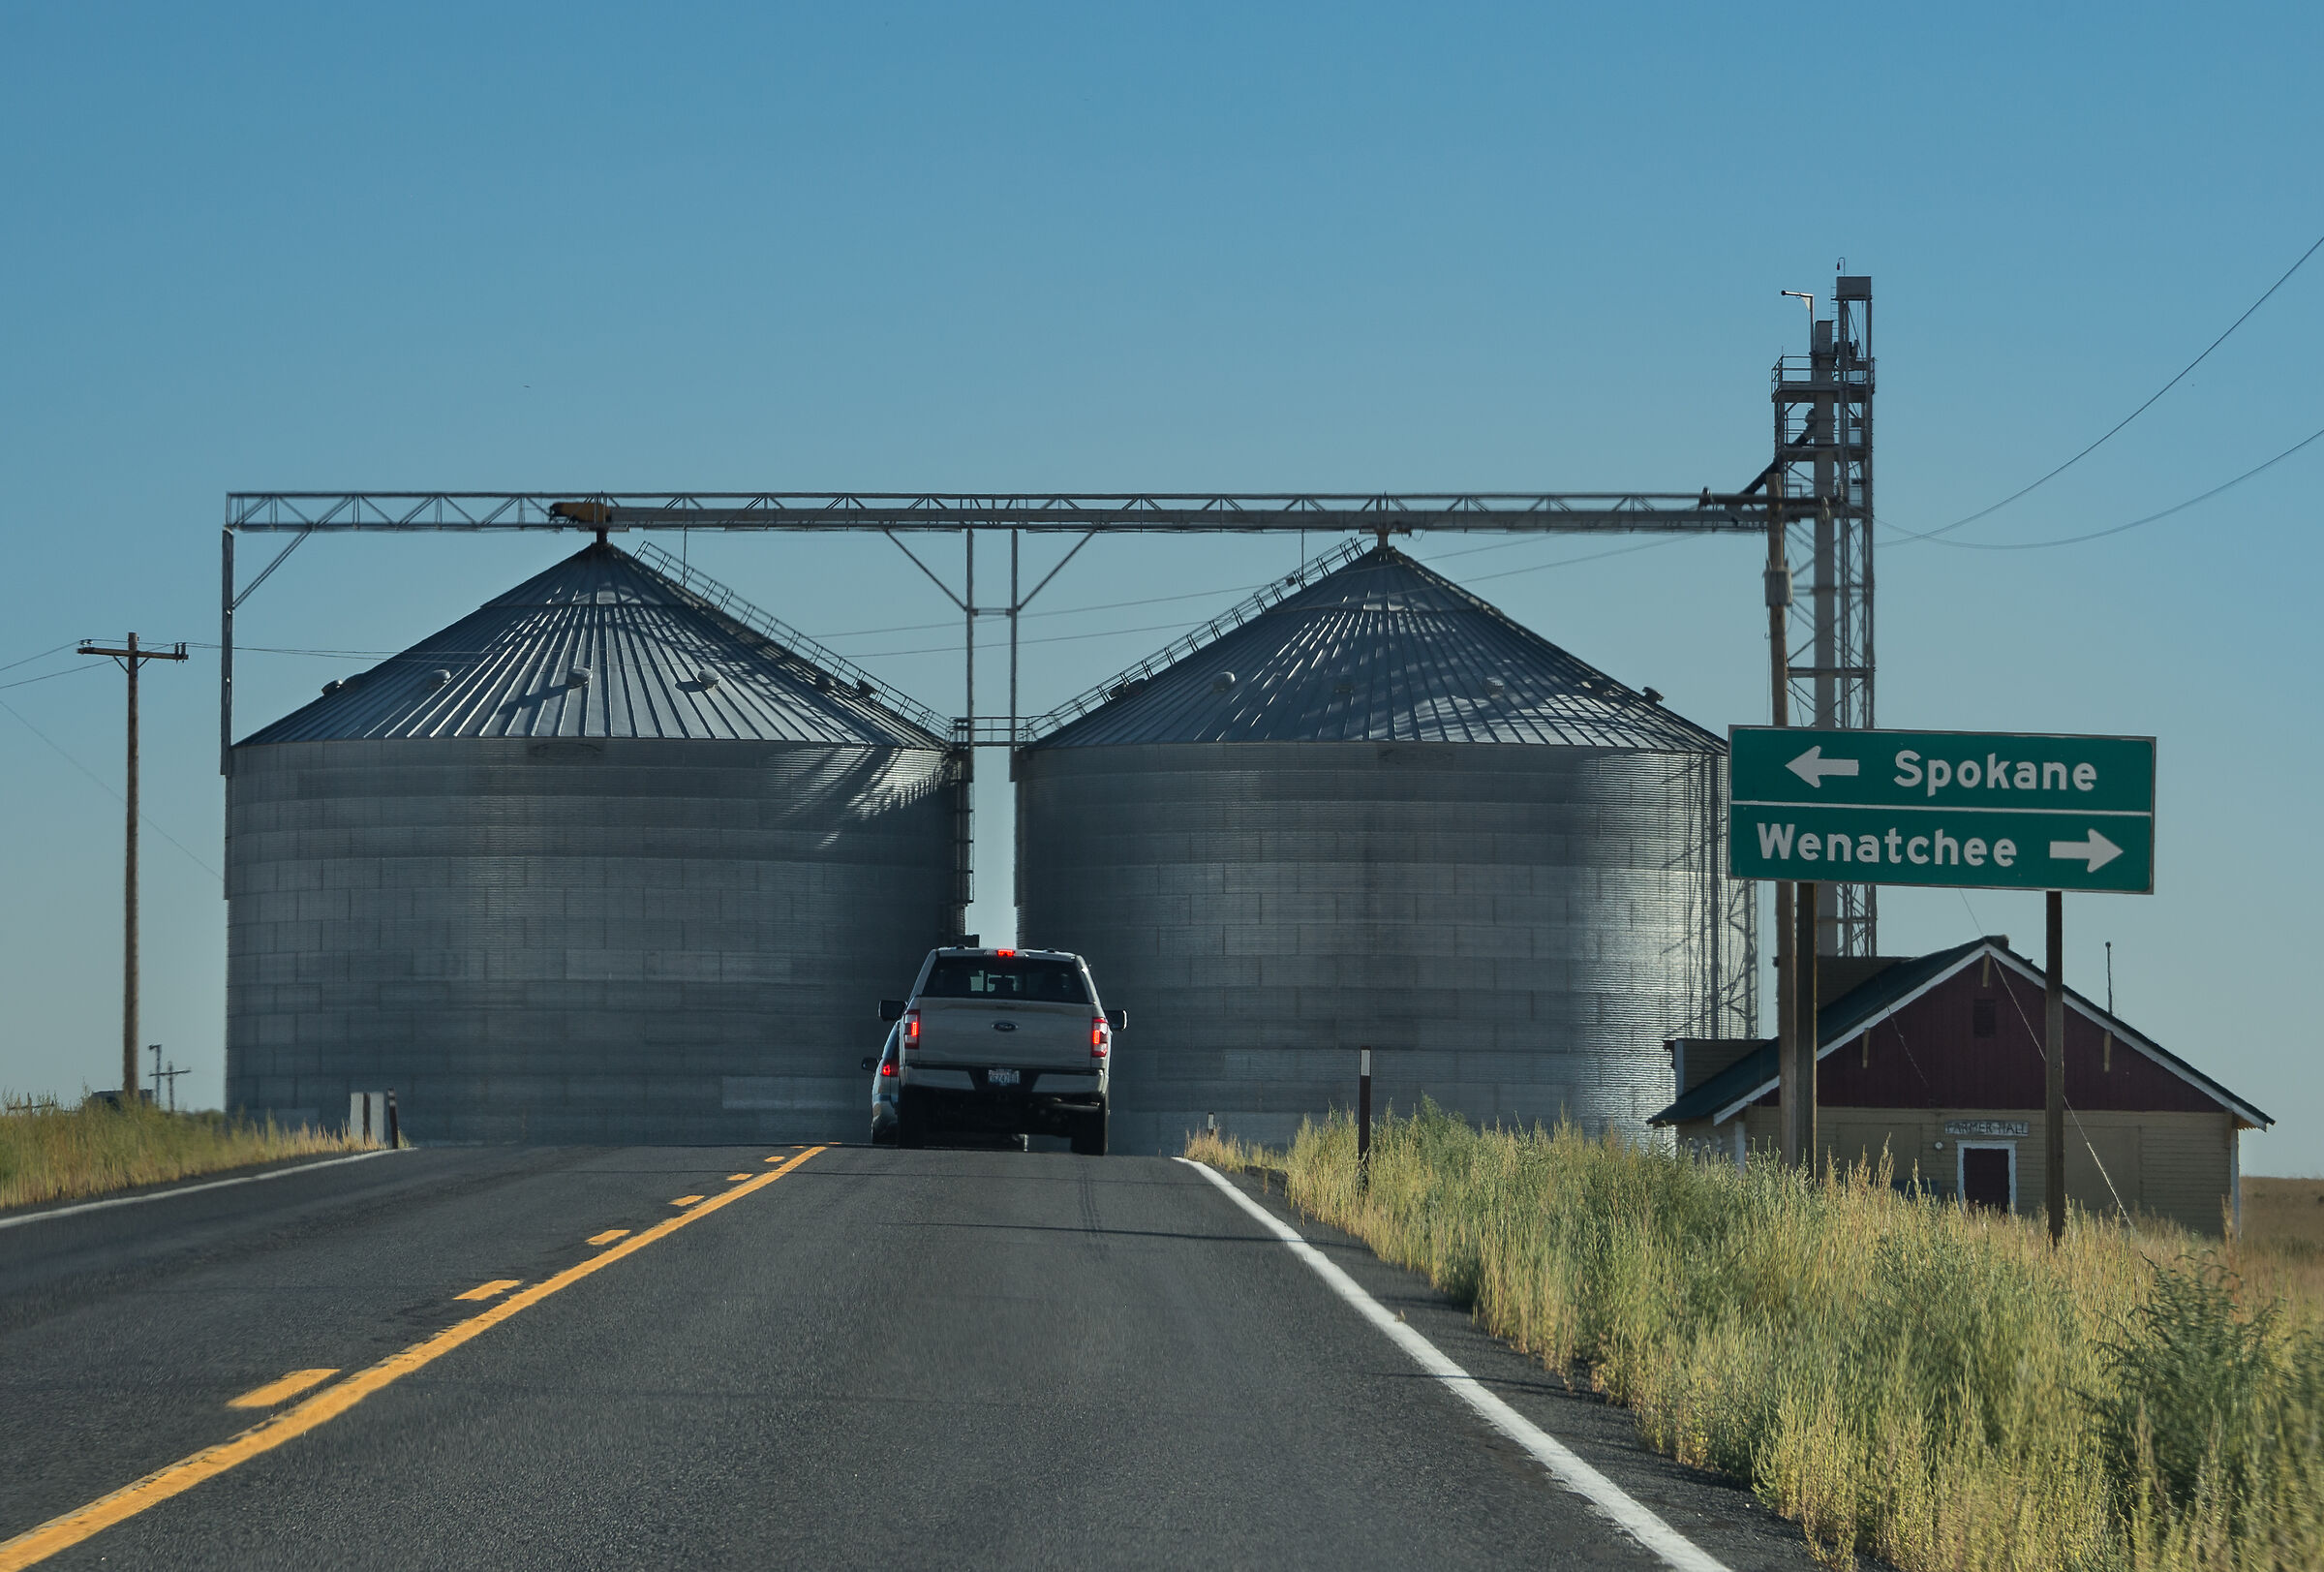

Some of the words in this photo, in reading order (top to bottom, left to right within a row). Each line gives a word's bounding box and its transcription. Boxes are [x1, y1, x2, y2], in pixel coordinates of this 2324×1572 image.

[1893, 750, 2097, 797] Spokane
[1757, 822, 2018, 868] Wenatchee
[1999, 1122, 2029, 1134] HALL
